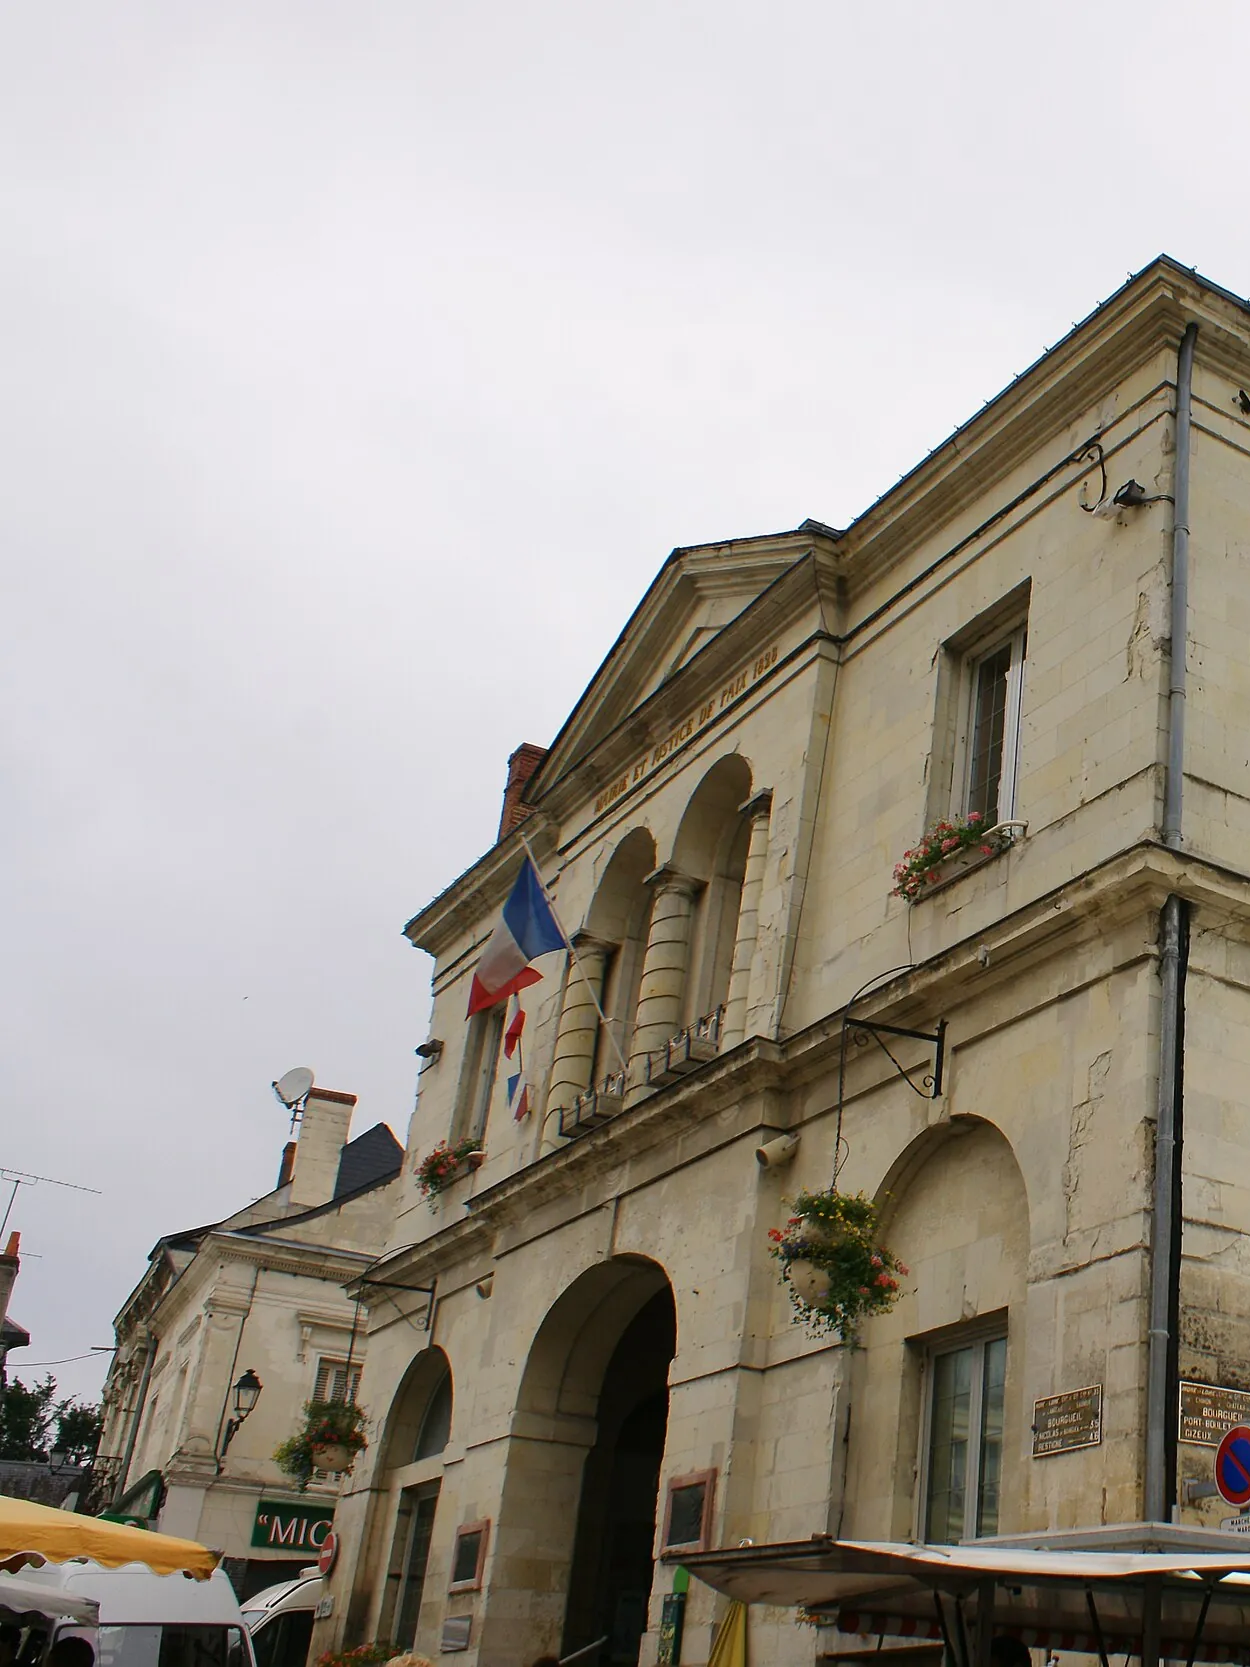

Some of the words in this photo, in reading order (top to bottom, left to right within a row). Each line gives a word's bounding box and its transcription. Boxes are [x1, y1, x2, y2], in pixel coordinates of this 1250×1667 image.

[633, 757, 648, 783] ET
[652, 719, 694, 766] JUSTICE
[699, 700, 716, 726] DE
[720, 670, 748, 708] PAIX
[1047, 1412, 1083, 1428] BOURGUEIL
[1202, 1407, 1243, 1422] BOURGUEIL
